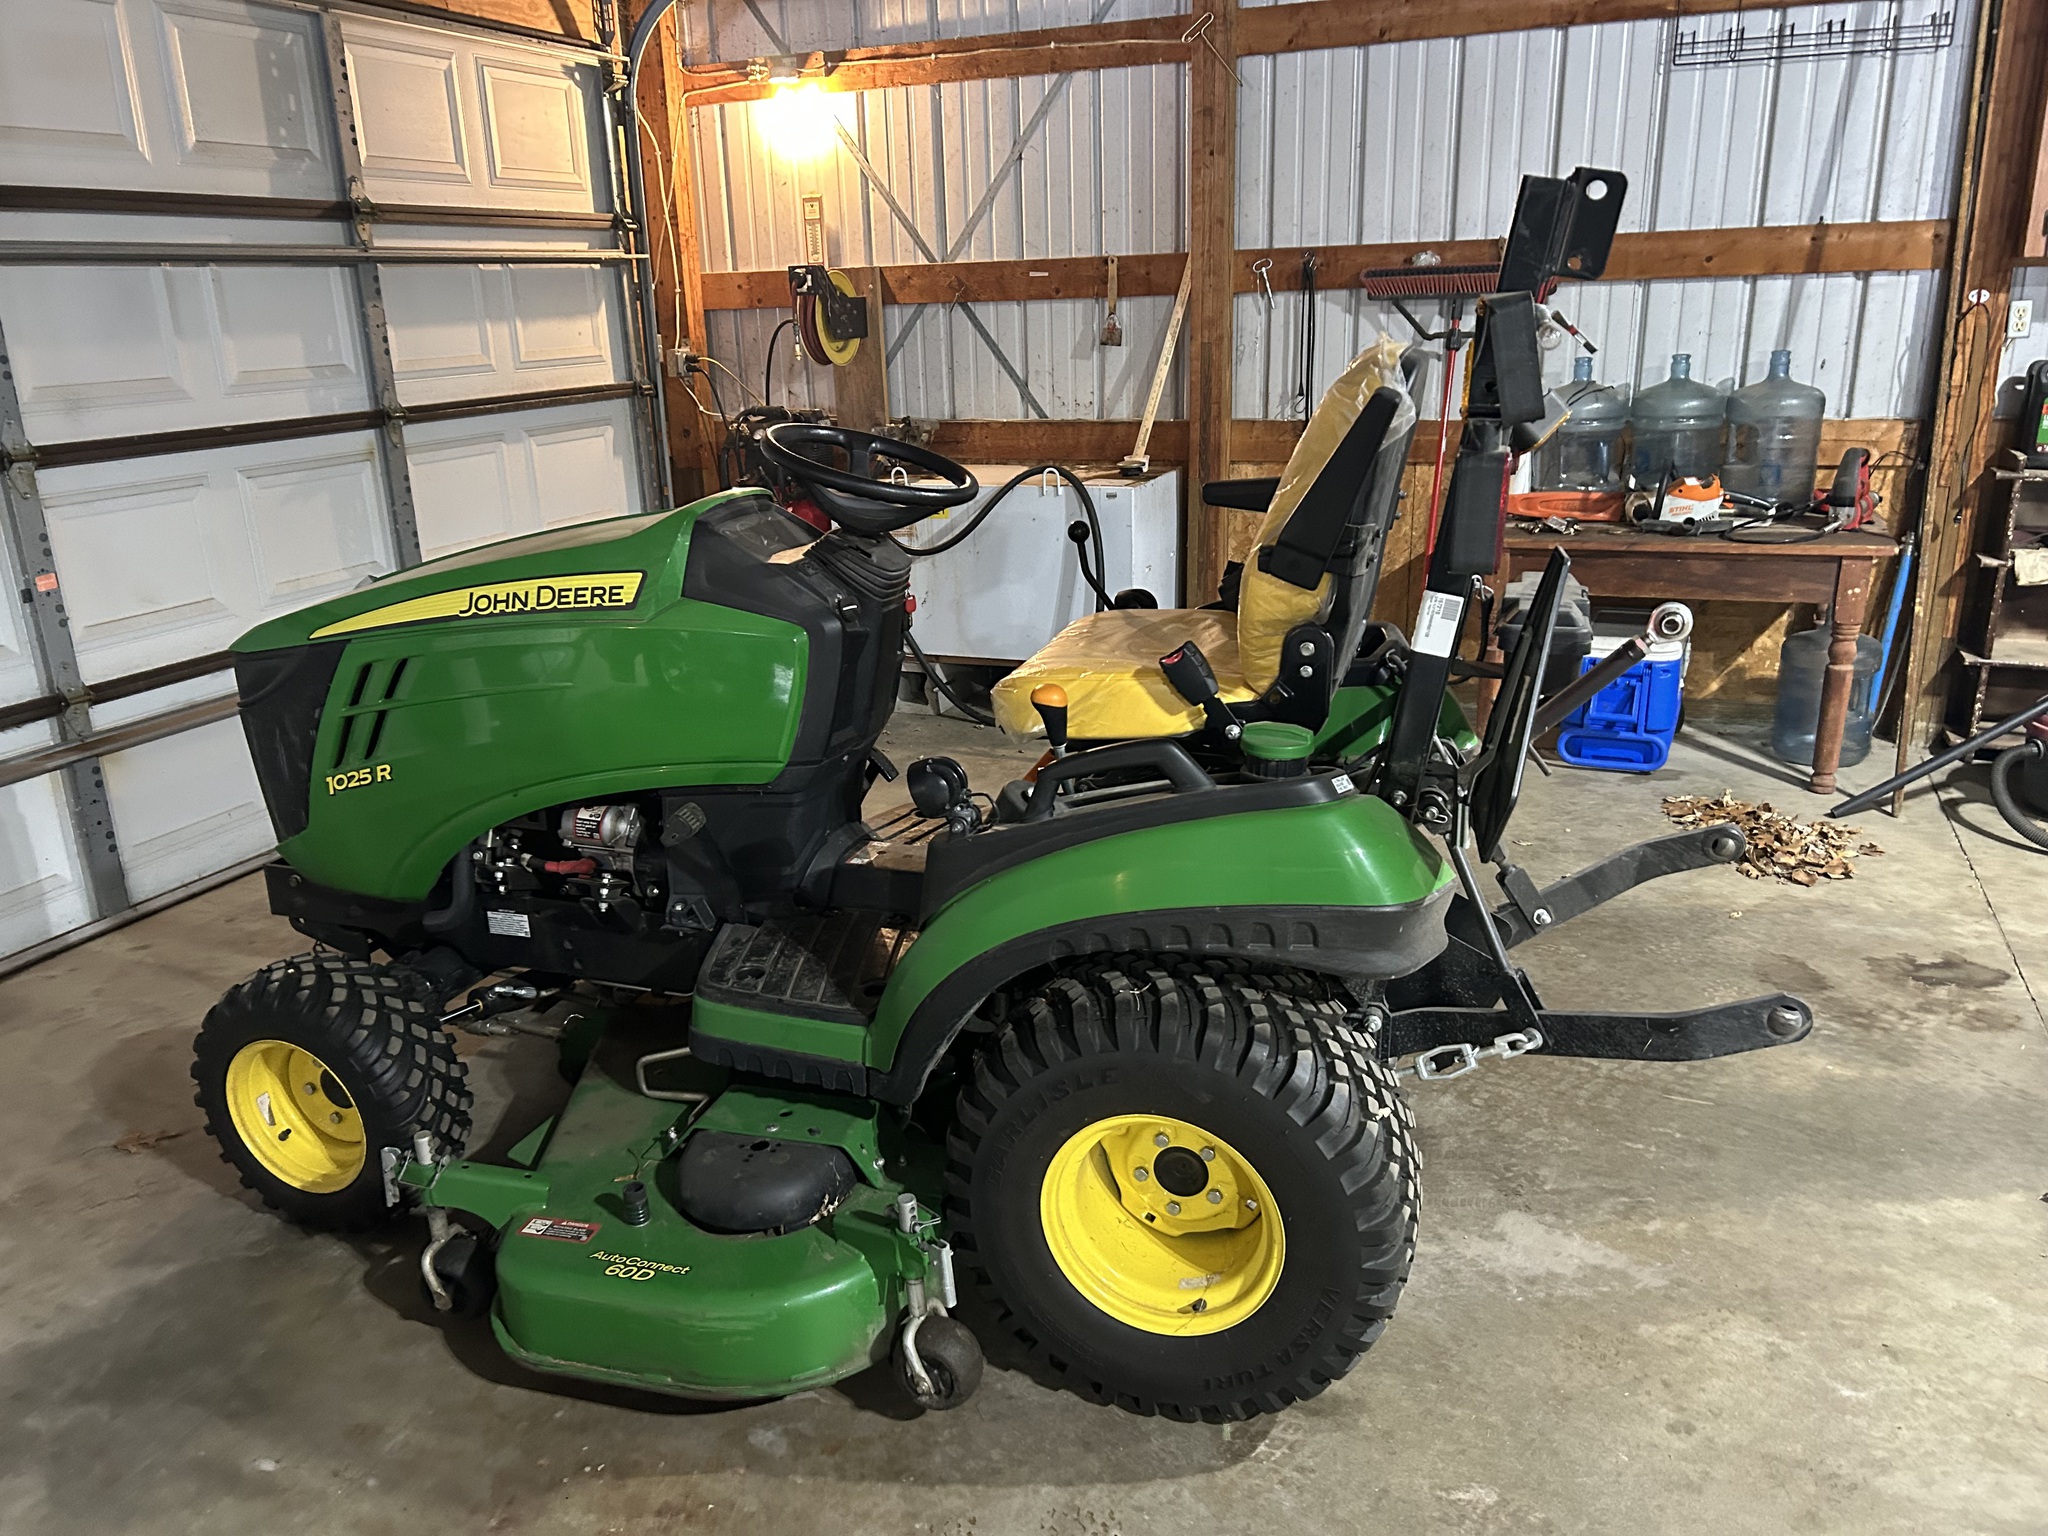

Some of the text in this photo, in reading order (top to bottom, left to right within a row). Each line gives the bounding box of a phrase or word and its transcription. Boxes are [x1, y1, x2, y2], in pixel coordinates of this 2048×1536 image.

[1669, 505, 1694, 513] STIHL
[459, 585, 624, 615] JOHN DEERE
[326, 764, 392, 795] 1025 R
[589, 1250, 690, 1274] AutoConnect
[604, 1264, 655, 1281] 60D
